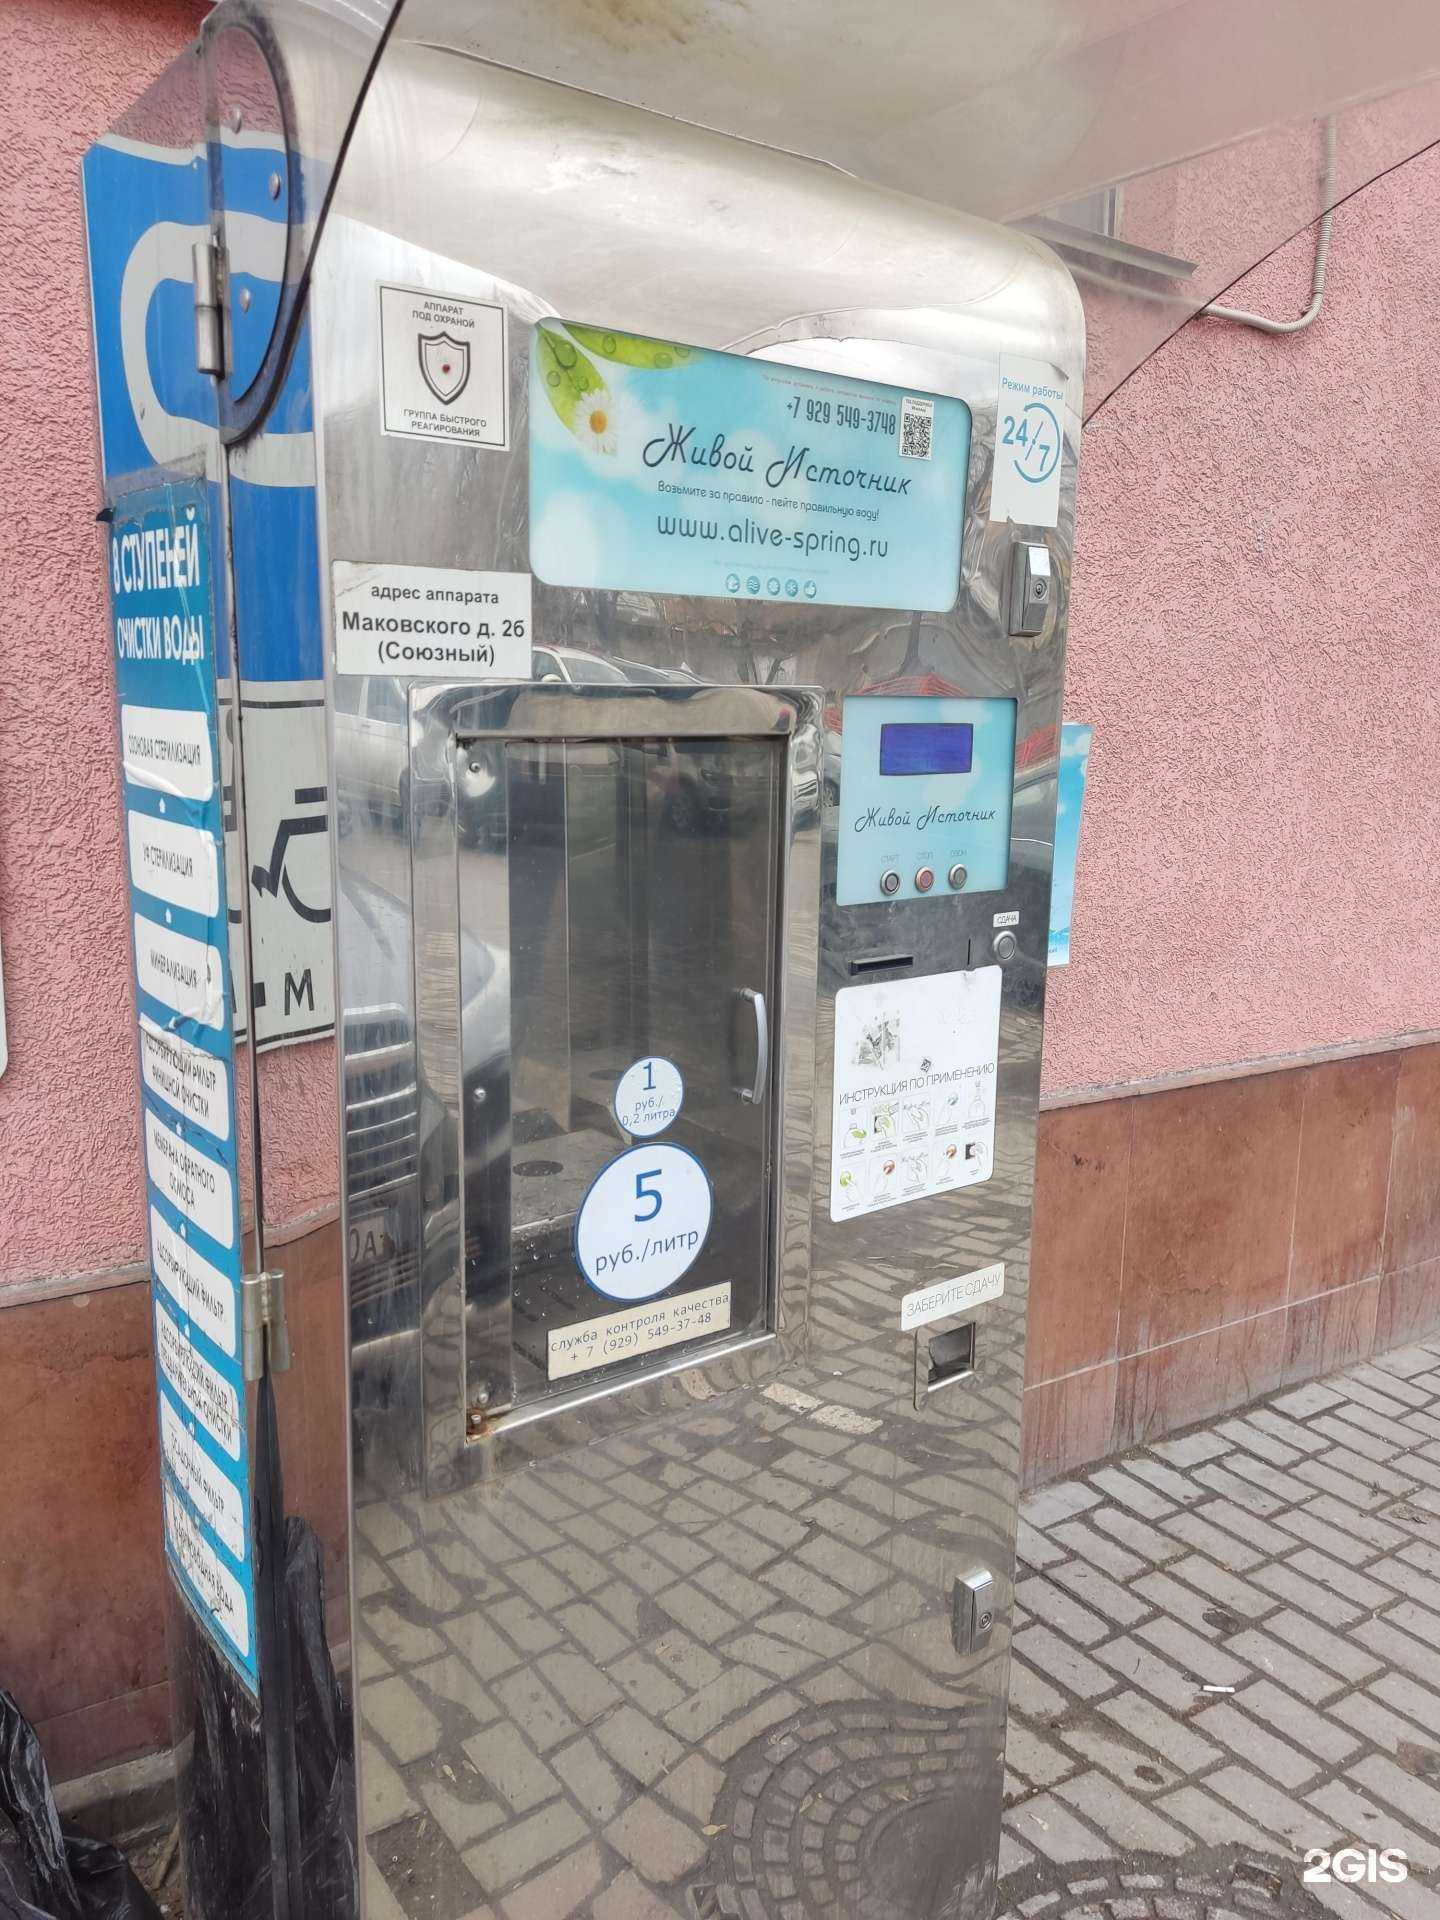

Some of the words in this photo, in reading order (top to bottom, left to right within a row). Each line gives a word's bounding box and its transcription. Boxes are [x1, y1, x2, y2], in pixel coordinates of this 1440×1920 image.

[412, 310, 433, 322] ПОД
[434, 313, 476, 329] ОХРАНОЙ
[424, 302, 464, 316] АППАРАТ
[1001, 376, 1030, 394] Режим
[1032, 385, 1064, 401] работы
[403, 409, 438, 423] ГРУППА
[439, 414, 487, 428] БЫСТРОГО
[411, 421, 480, 437] РЕАГИРОВАНИЯ
[807, 399, 831, 424] 929
[836, 404, 896, 435] 549-3748
[642, 423, 754, 467] Живой
[766, 445, 912, 495] Источник
[658, 480, 706, 500] Возьмите
[709, 490, 721, 500] за
[723, 491, 763, 505] правило
[771, 497, 798, 510] пейте
[800, 501, 854, 516] правильную
[856, 509, 880, 520] воду!
[112, 536, 121, 594] 8
[121, 506, 200, 594] СТУПЕНЕЙ
[657, 515, 888, 561] www.alive-spring.ru
[371, 585, 422, 602] адрес
[425, 589, 499, 605] аппарата
[117, 616, 162, 661] ОЧИСТКИ
[163, 614, 205, 667] ВОДЫ
[342, 611, 471, 636] Маковского
[476, 624, 496, 639] д.
[378, 640, 495, 667] (Союзный)
[854, 806, 911, 832] Живой
[916, 805, 997, 831] Источник
[643, 1061, 657, 1091] 1
[839, 1079, 908, 1105] ИНСТРУКЦИЯ
[909, 1077, 925, 1090] ПО
[925, 1062, 995, 1087] ПРИМЕНЕНИЮ
[622, 1113, 640, 1126] 0,2
[644, 1108, 676, 1122] литра
[635, 1095, 664, 1113] руб./
[179, 1157, 216, 1195] ОБРАТНОГО
[633, 1168, 662, 1223] 5
[595, 1229, 699, 1276] руб./литр
[905, 1288, 965, 1318] ЗАБЕРИТЕ
[965, 1270, 1002, 1297] СДАЧУ
[551, 1330, 598, 1353] служба
[606, 1311, 666, 1336] контроля
[672, 1293, 729, 1317] качества
[586, 1345, 594, 1359] 7
[603, 1332, 639, 1355] (929)
[647, 1312, 712, 1341] 549-37-48
